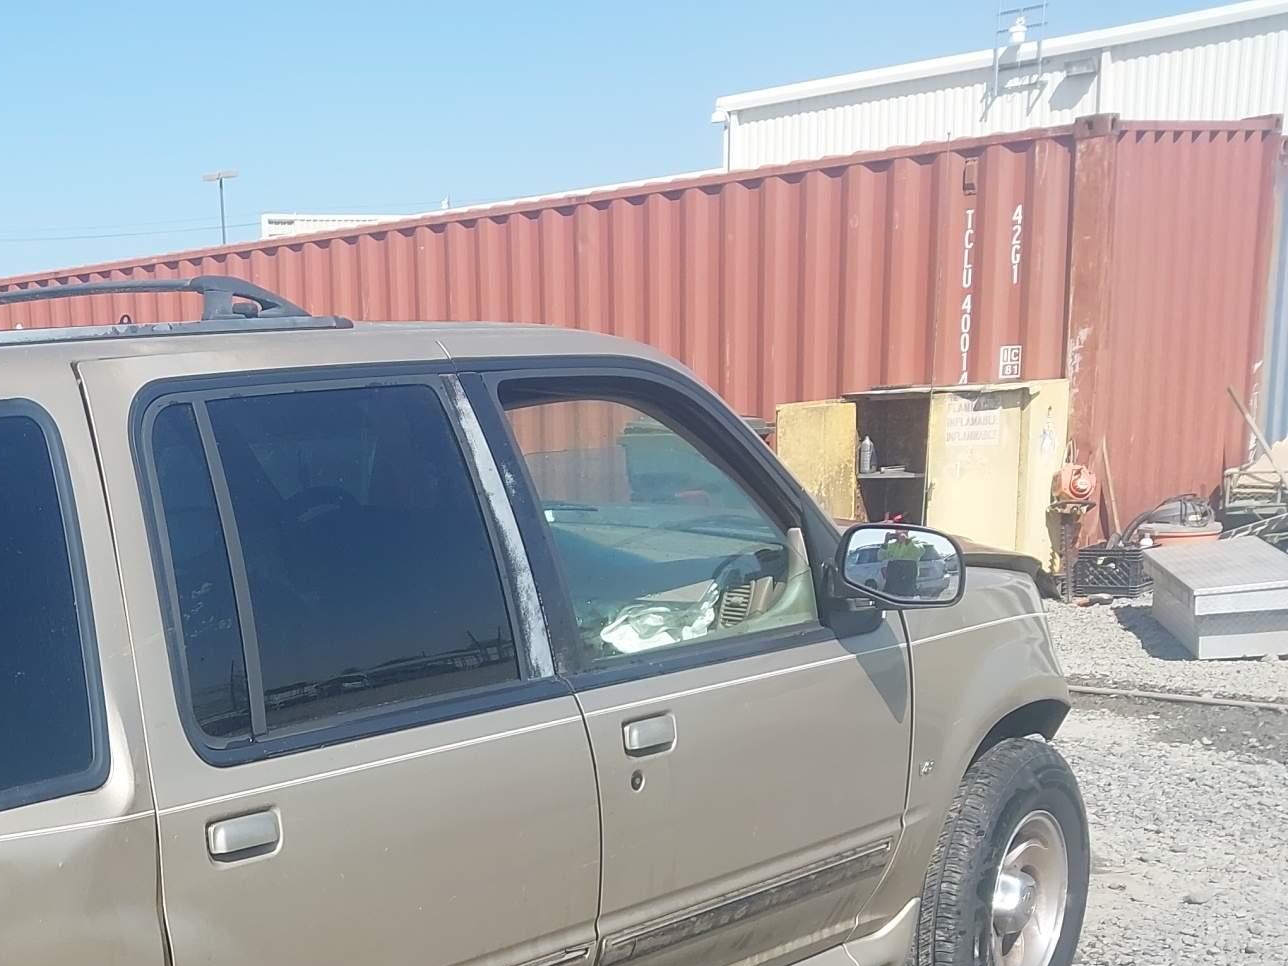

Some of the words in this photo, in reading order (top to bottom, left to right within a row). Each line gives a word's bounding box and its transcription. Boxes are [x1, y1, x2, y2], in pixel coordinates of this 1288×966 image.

[963, 209, 975, 288] TCLU
[1011, 204, 1022, 284] 42G1
[1003, 349, 1019, 362] IC
